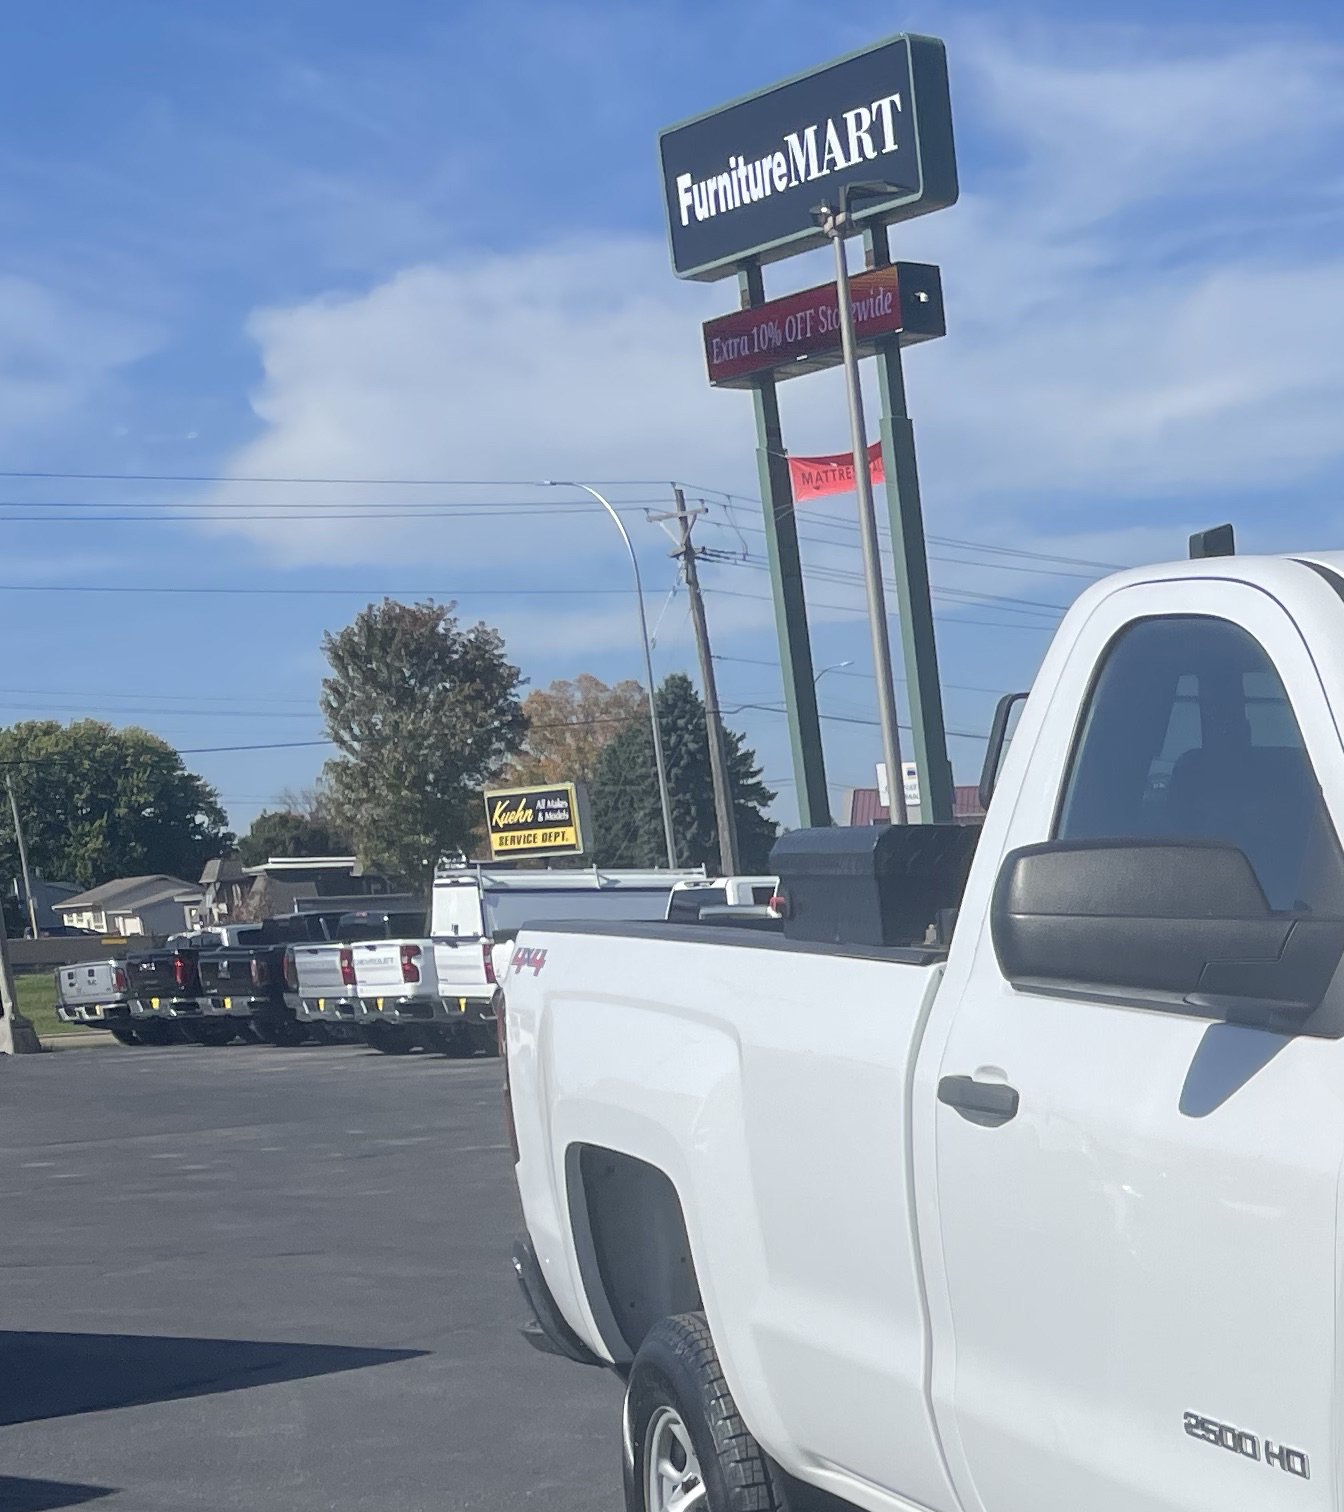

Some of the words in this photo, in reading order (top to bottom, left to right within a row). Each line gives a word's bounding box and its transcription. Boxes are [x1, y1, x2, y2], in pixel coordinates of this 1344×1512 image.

[677, 93, 902, 226] FurnitureMART
[711, 336, 748, 364] Extra
[751, 320, 782, 353] 10%
[784, 307, 815, 343] OFF
[818, 288, 893, 333] Stoewide
[801, 465, 859, 486] MATTRE
[492, 798, 534, 828] Kuehn
[536, 799, 546, 810] All
[546, 798, 568, 809] Makes
[538, 812, 543, 822] &
[545, 810, 569, 821] Models
[498, 833, 537, 847] SERVICE
[1183, 1410, 1261, 1462] 2500
[1265, 1439, 1310, 1480] HD
